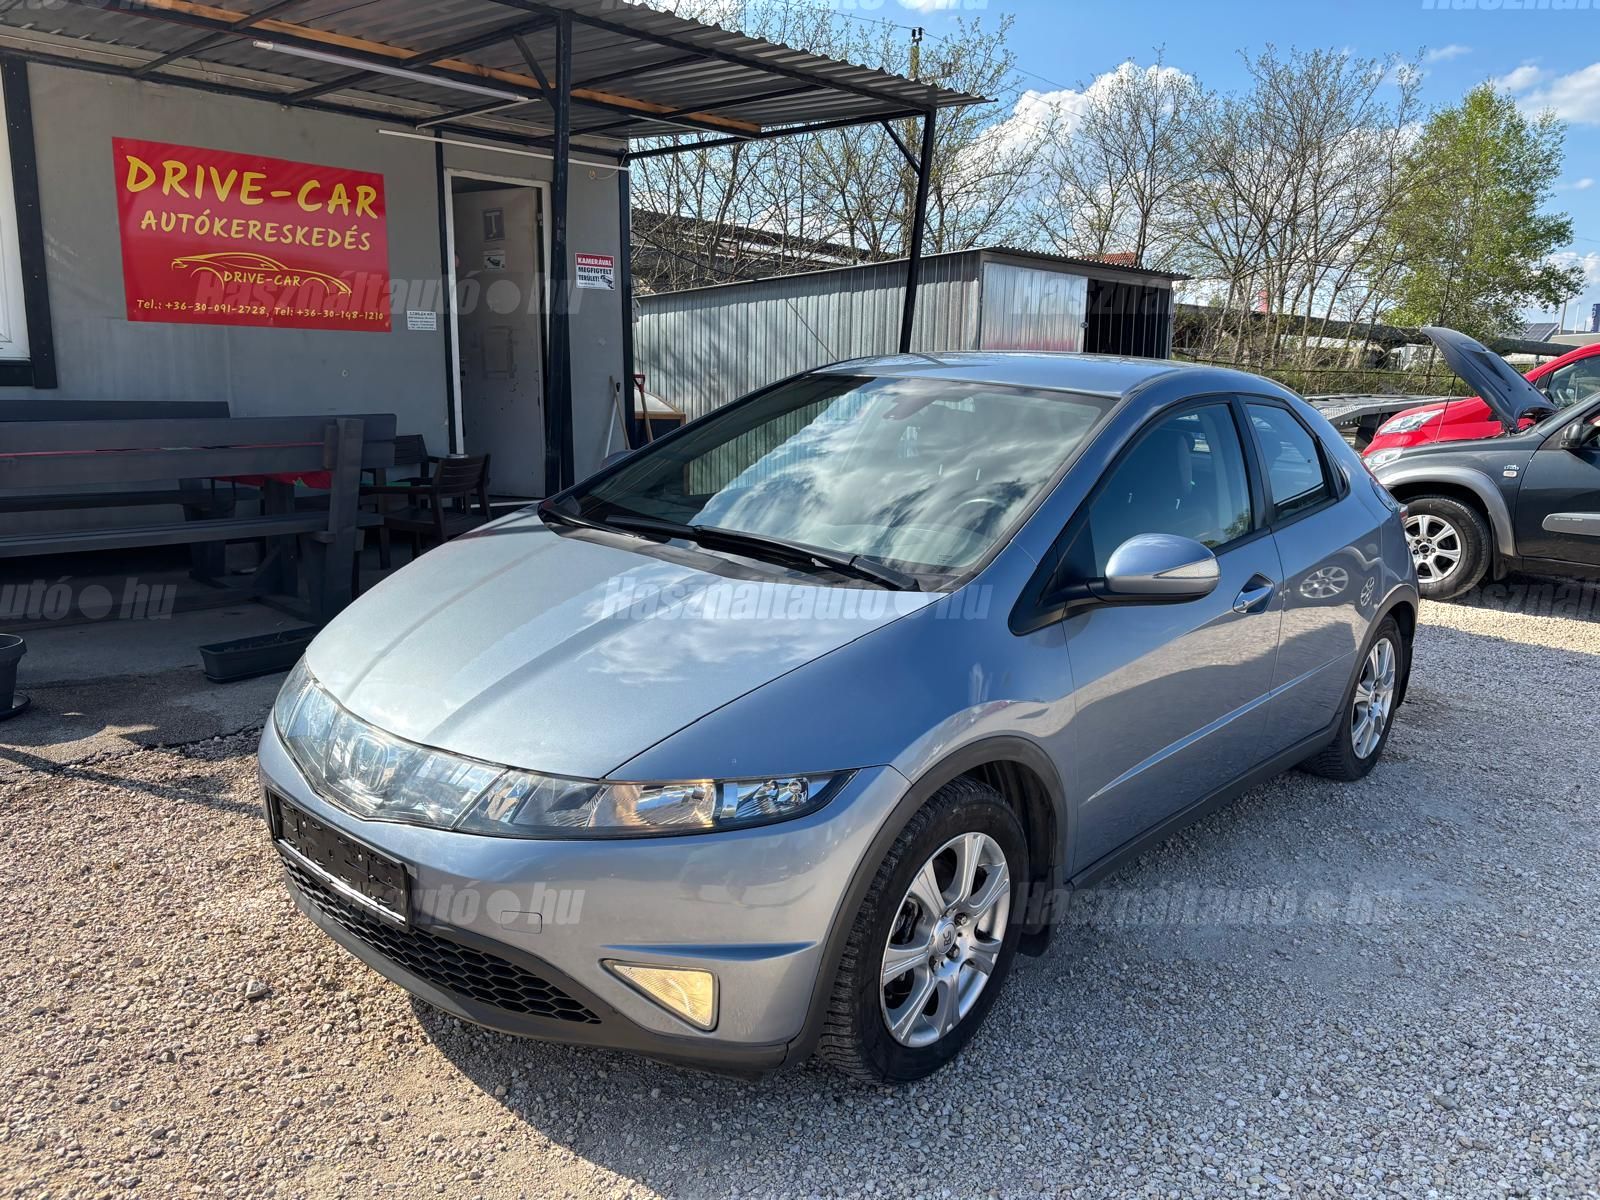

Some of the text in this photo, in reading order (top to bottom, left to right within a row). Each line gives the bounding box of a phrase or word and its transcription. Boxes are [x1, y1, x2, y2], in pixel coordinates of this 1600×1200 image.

[126, 155, 378, 219] DRIVE-CAR
[140, 209, 371, 250] AUTÓKERESKEDÉS
[577, 257, 612, 266] KAMERÁVAL
[223, 270, 301, 287] DRIVE-CAR
[578, 266, 612, 275] MEGFIGYELT
[578, 274, 600, 282] TERÜLET!
[136, 299, 162, 310] Tel.:
[274, 306, 294, 316] Tel:
